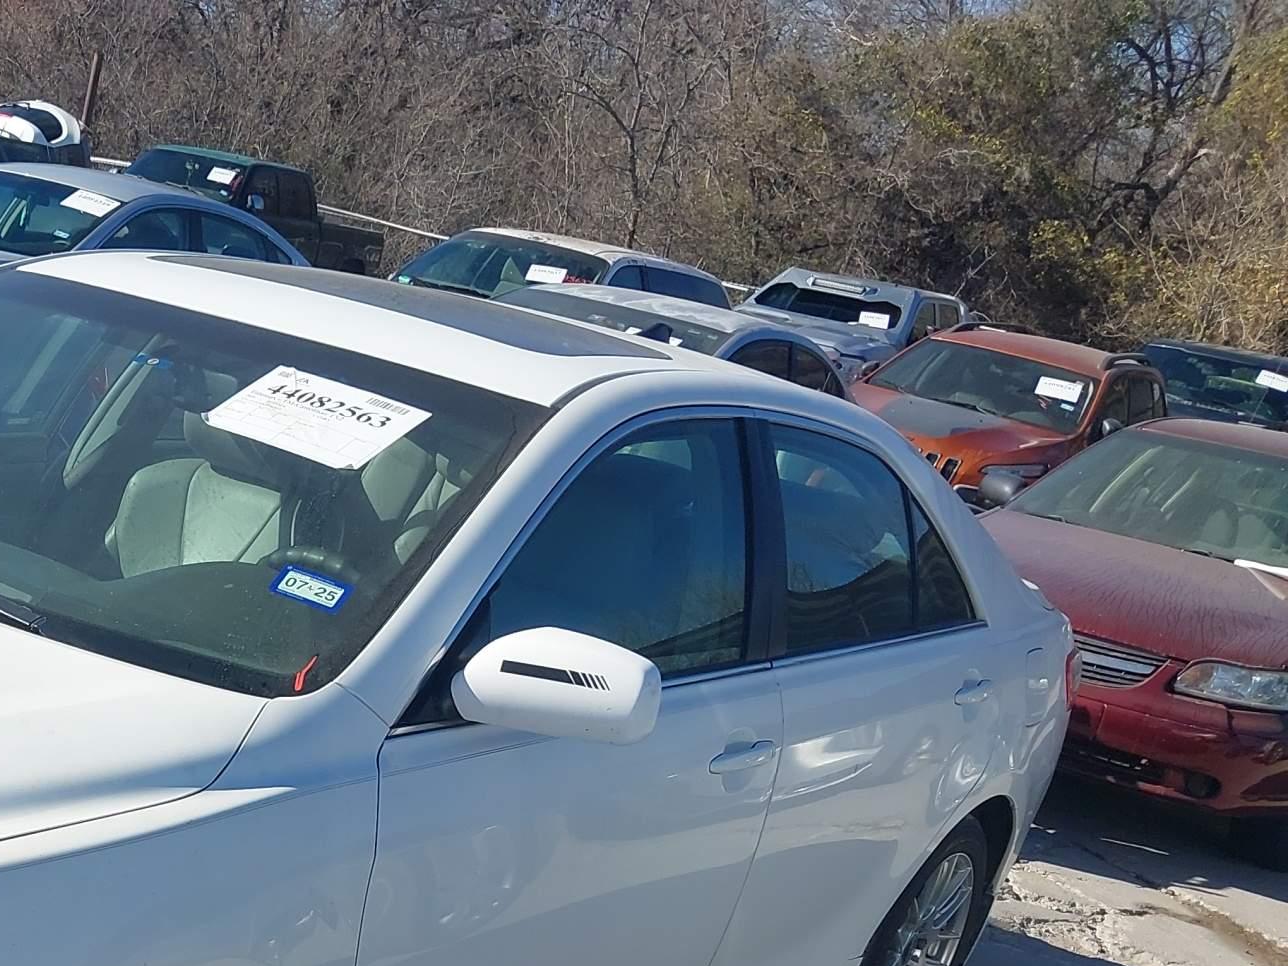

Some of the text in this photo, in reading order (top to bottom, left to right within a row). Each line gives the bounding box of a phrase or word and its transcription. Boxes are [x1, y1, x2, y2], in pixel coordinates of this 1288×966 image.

[267, 384, 392, 428] 44082563
[285, 577, 338, 602] 07 25
